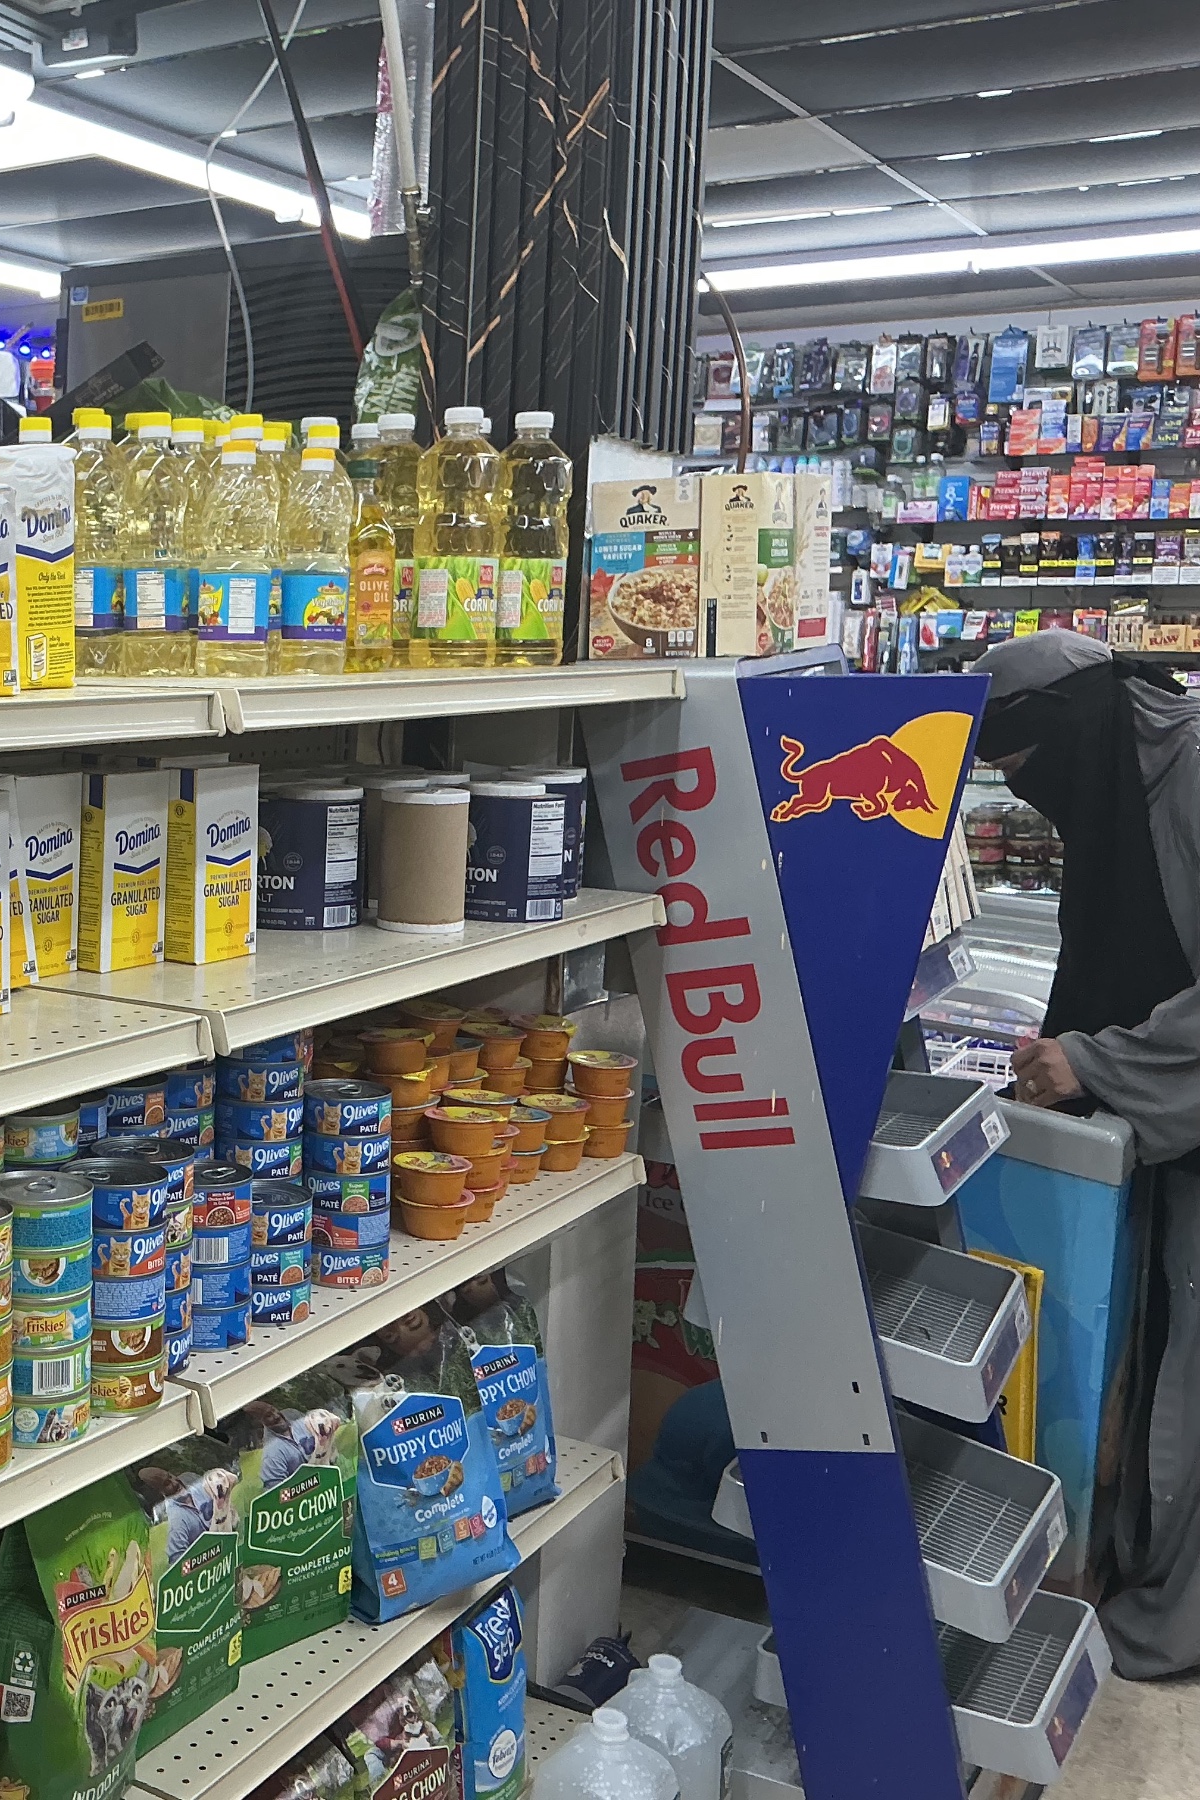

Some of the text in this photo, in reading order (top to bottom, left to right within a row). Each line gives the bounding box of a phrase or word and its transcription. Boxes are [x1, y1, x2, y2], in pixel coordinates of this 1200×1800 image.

[1158, 434, 1179, 442] Advil
[725, 502, 754, 511] QUAKER
[989, 503, 1017, 511] TYLENOL
[619, 514, 670, 528] QUAKER
[360, 581, 389, 591] OLIVE
[374, 592, 389, 603] OIL
[464, 598, 488, 612] CORN
[538, 599, 557, 612] CORN
[1150, 634, 1179, 646] RAW
[25, 828, 74, 861] Domino
[111, 886, 161, 907] GRANULATED
[203, 879, 252, 898] GRANULATED
[218, 894, 240, 909] SUGAR
[620, 746, 795, 1151] Red Bull
[269, 1067, 299, 1092] 9Lives
[343, 1103, 378, 1127] 9Lives
[255, 1148, 290, 1170] 9Lives
[644, 1192, 674, 1211] Ice
[271, 1209, 304, 1232] 9Lives
[148, 1259, 164, 1270] BITES
[323, 1255, 360, 1276] 9Lives
[337, 1275, 359, 1284] BITES
[26, 1320, 64, 1334] Friskies
[484, 1355, 517, 1375] PURINA
[404, 1407, 443, 1428] PURINA
[372, 1418, 463, 1467] PUPPY CHOW
[498, 1434, 534, 1459] Complete
[290, 1477, 319, 1496] PURINA
[256, 1507, 294, 1534] DOG
[298, 1486, 338, 1520] CHOW
[415, 1493, 464, 1523] Complete
[191, 1544, 221, 1568] PURINA
[162, 1553, 233, 1614] DOG CHOW
[66, 1588, 104, 1606] PURINA
[70, 1600, 149, 1662] Friskies
